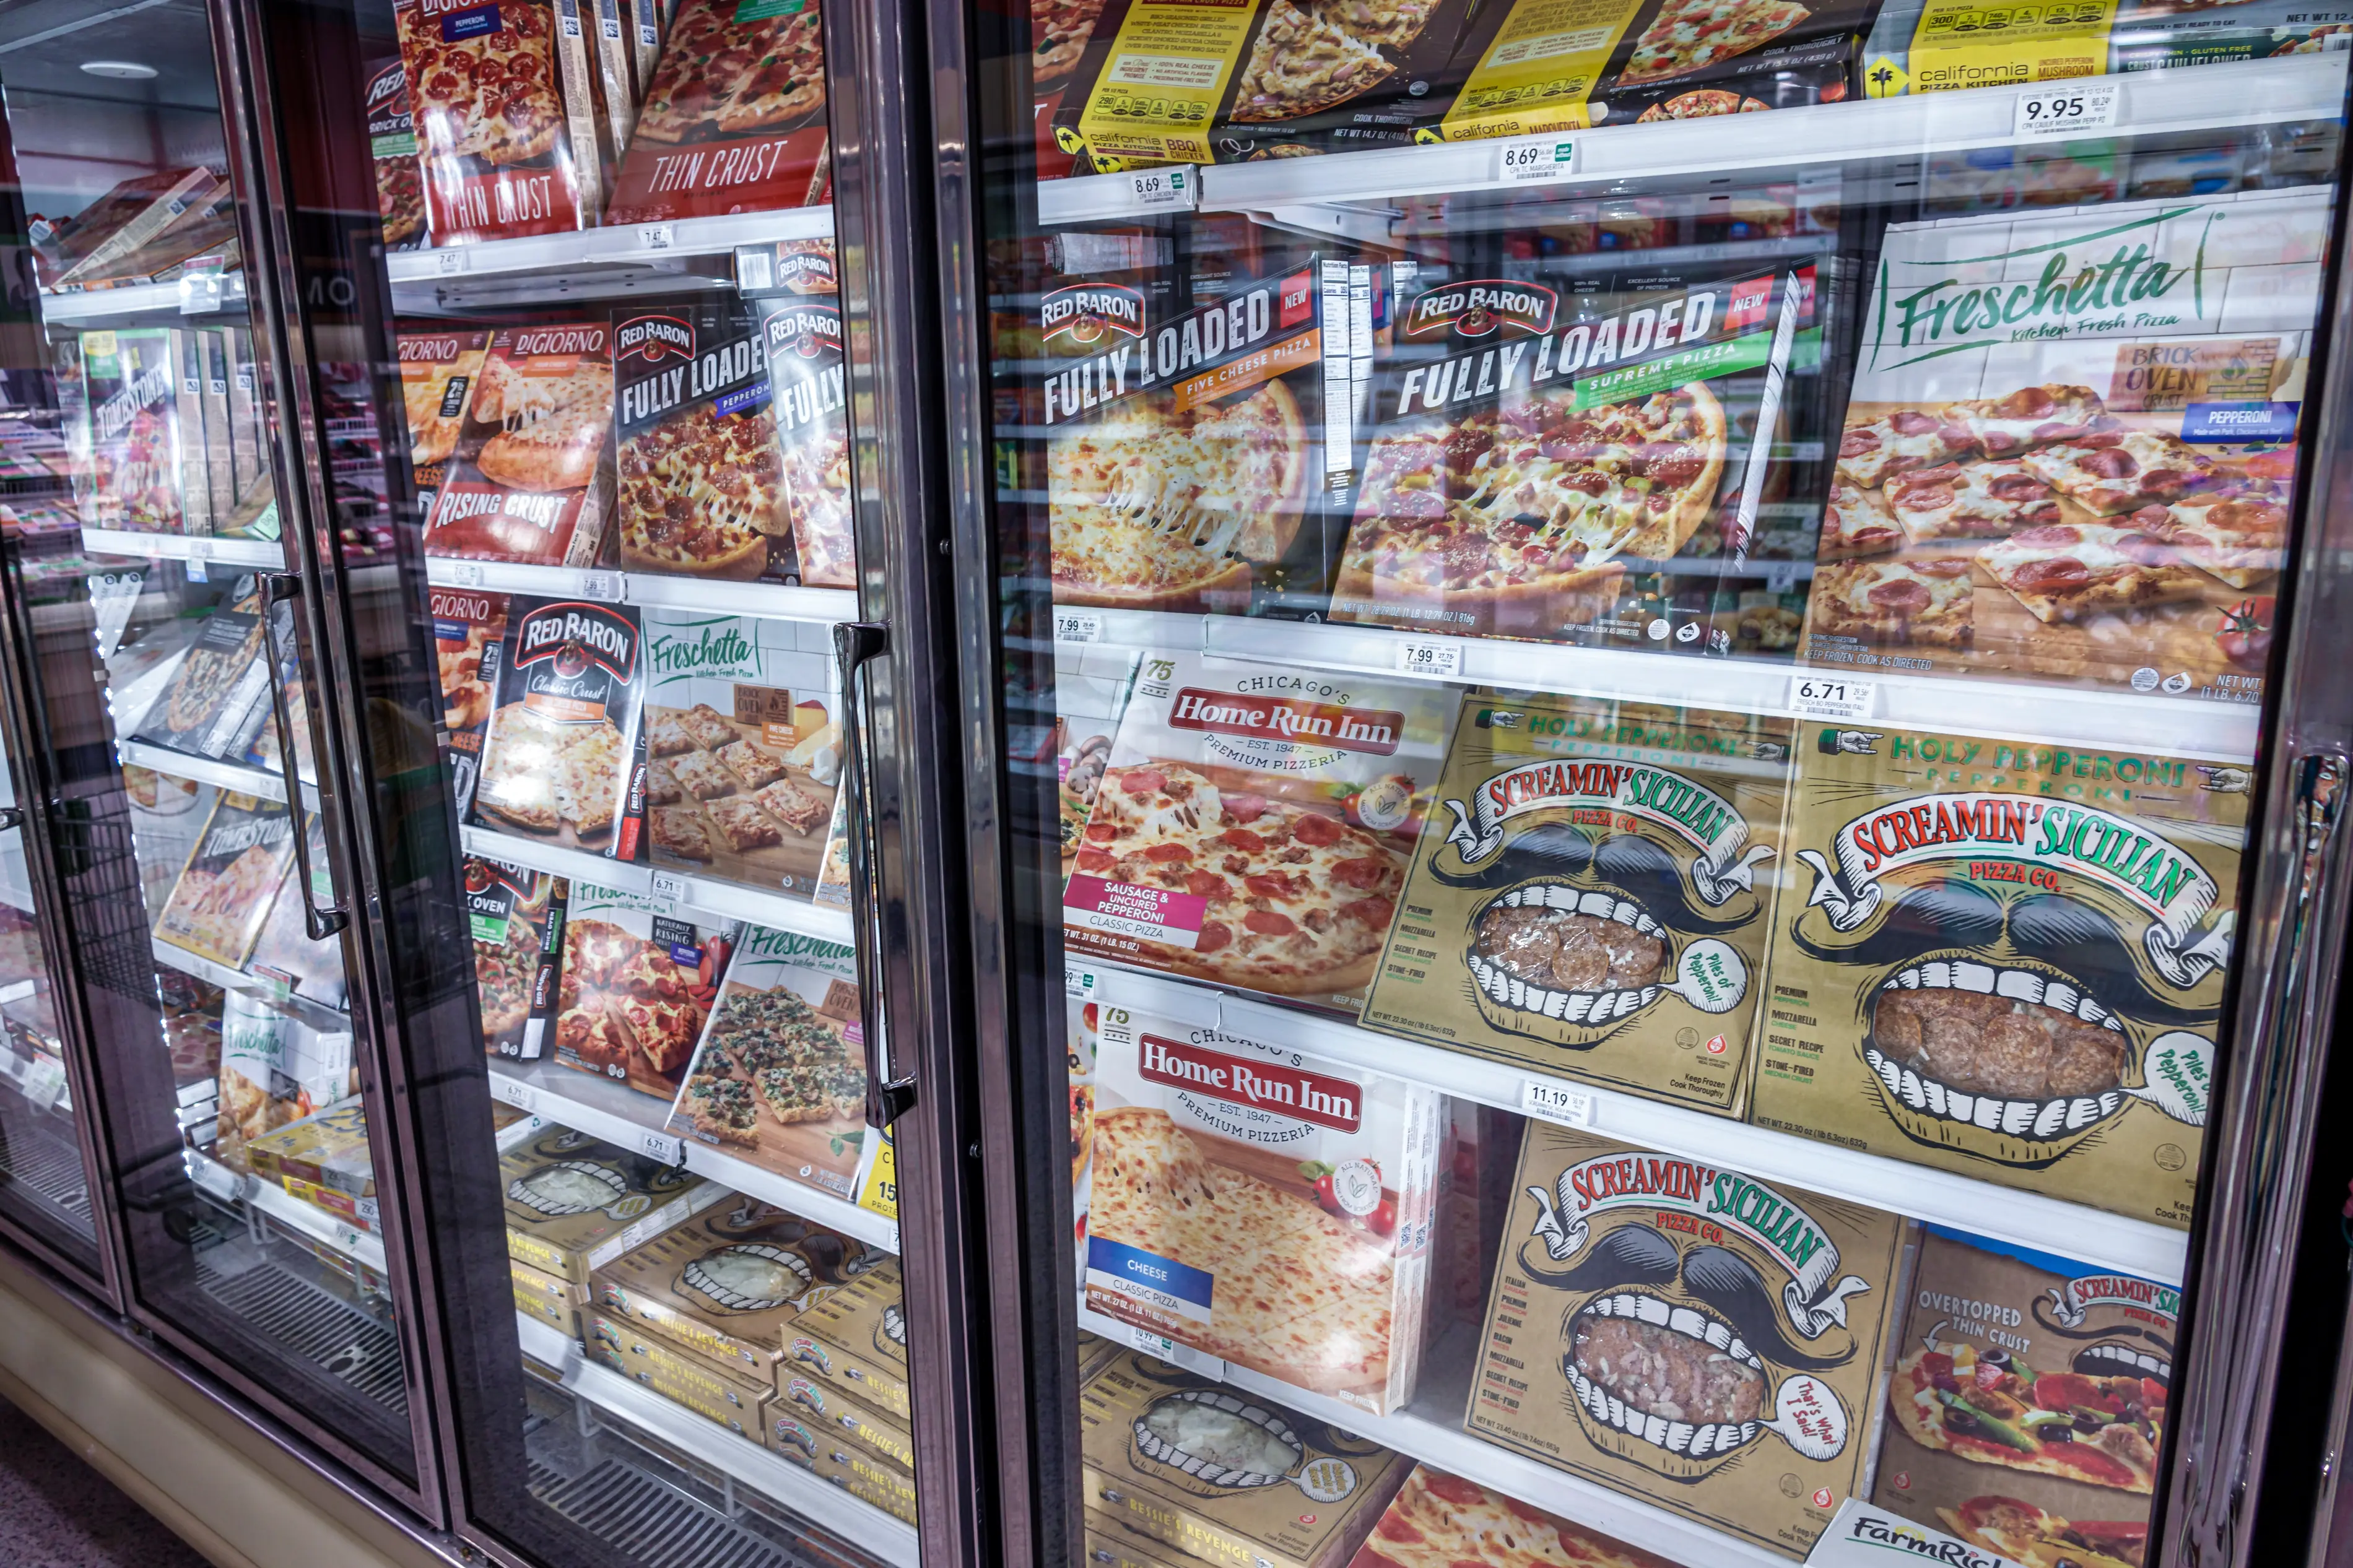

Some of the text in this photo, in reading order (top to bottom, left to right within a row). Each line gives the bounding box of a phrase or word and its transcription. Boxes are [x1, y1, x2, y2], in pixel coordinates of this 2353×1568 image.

[455, 15, 485, 27] PEPPERONI
[1931, 16, 1954, 24] 300
[2286, 13, 2330, 23] NET WT
[1763, 35, 1844, 57] COOK THOROUGHLY
[2191, 46, 2226, 54] GLUTEN
[1920, 62, 2029, 82] california
[2038, 65, 2094, 77] MUSHROOM
[2128, 60, 2154, 71] CRUST
[368, 71, 405, 105] RED
[1354, 114, 1372, 123] COOK
[2026, 97, 2084, 120] 9.95
[1090, 131, 1161, 145] california
[1453, 119, 1520, 139] california
[1166, 139, 1197, 152] BBQ
[1170, 150, 1206, 161] CHICKEN
[648, 140, 788, 193] THIN CRUST
[1505, 148, 1537, 166] 8.69
[683, 190, 726, 200] ORIGINAL
[1136, 178, 1159, 193] 8.69
[445, 176, 551, 230] THIN CRUST
[645, 232, 661, 242] 7.47
[440, 254, 456, 264] 7.47
[780, 256, 830, 276] RED BARON
[1284, 288, 1307, 310] NEW
[1419, 287, 1544, 322] RED BARON
[1733, 292, 1765, 313] NEW
[1895, 243, 2191, 347] Freschetta
[1042, 292, 1136, 329] RED BARON
[620, 322, 690, 349] RED BARON
[2011, 312, 2182, 343] Kitchen Fresh Pizza
[1045, 345, 1130, 425] FULLY
[1141, 290, 1269, 385] LOADED
[1397, 341, 1528, 415] FULLY
[1533, 292, 1716, 382] LOADED
[2133, 346, 2200, 366] BRICK
[1187, 376, 1214, 395] FIVE
[1219, 354, 1268, 381] CHEESE
[1274, 337, 1311, 360] PIZZA
[1590, 343, 1735, 391] SUPREME PIZZA
[622, 334, 768, 425] FULLY LOADE
[2126, 367, 2198, 391] OVEN
[97, 365, 165, 441] TOMBSTONE
[782, 363, 844, 431] FULLY
[2143, 394, 2185, 409] CRUST
[2208, 410, 2273, 424] PEPPERONI
[435, 493, 568, 534] RISING CRUST
[1059, 619, 1079, 631] 7.99
[525, 613, 629, 663] RED BARON
[651, 627, 754, 674] Freschetta
[1407, 649, 1433, 662] 7.99
[1803, 649, 1932, 670] KEEP FROZEN, COOK AS DIRECTED
[531, 674, 607, 700] Classic Crust
[737, 687, 761, 699] BRICK
[1237, 675, 1351, 706] CHICAGO'S
[1800, 682, 1845, 701] 6.71
[2217, 675, 2261, 690] NET WT.
[2201, 685, 2259, 703] (1 LB. 6.70
[737, 699, 761, 713] OVEN
[1174, 695, 1393, 744] Home Run Inn
[1529, 714, 1739, 756] HOLY PEPPERONI
[1204, 733, 1348, 770] PREMIUM PIZZERIA
[1246, 739, 1302, 755] EST. 1947
[1890, 736, 2186, 787] HOLY PEPPERONI
[630, 767, 645, 810] RED BARON
[1926, 768, 2131, 802] PEPPERONI
[1489, 762, 1738, 846] SCREAMIN' SICILIAN
[1572, 809, 1638, 833] PIZZA CO.
[204, 816, 291, 859] TOMBSTON
[1853, 800, 2196, 908] SCREAMIN' SICILIAN
[656, 879, 674, 891] 6.71
[1969, 862, 2061, 893] PIZZA CO.
[1104, 881, 1168, 904] SAUSAGE &
[1110, 894, 1158, 911] UNCURED
[474, 897, 506, 914] OVEN
[1097, 901, 1165, 924] PEPPERONI
[1407, 904, 1433, 916] PREMIUM
[656, 918, 690, 933] NATURALLY
[1090, 916, 1163, 938] CLASSIC PIZZA
[656, 929, 690, 946] RISING
[1394, 944, 1437, 959] SECRET RECIPE
[537, 968, 549, 991] BARON
[830, 995, 855, 1012] OVEN
[1332, 994, 1350, 1005] KEEP
[1772, 1010, 1817, 1026] MOZZARELLA
[1769, 1034, 1824, 1053] SECRET RECIPE
[1765, 1059, 1814, 1076] STONE-FIRED
[1143, 1042, 1228, 1089] Home
[1231, 1064, 1295, 1106] Run
[1300, 1080, 1355, 1121] Inn
[1670, 1079, 1724, 1099] Cook Thoroughly
[1684, 1073, 1726, 1089] Keep Frozen
[507, 1086, 522, 1098] 6.71
[1533, 1086, 1568, 1107] 11.19
[1177, 1091, 1316, 1143] PREMIUM PIZZERIA
[1219, 1103, 1271, 1124] EST. 1947
[1757, 1115, 1770, 1125] NET
[1772, 1119, 1783, 1128] WT.
[1784, 1122, 1803, 1133] 22.30
[1827, 1132, 1849, 1145] 6.3oz)
[1849, 1137, 1868, 1150] 632g
[646, 1137, 663, 1151] 6.71
[1572, 1158, 1825, 1270] SCREAMIN' SICILIAN
[2155, 1207, 2178, 1220] Cook
[1656, 1213, 1725, 1246] PIZZA CO.
[1127, 1260, 1168, 1281] CHEESE
[1113, 1280, 1178, 1310] CLASSIC PIZZA
[2074, 1277, 2160, 1304] SCREAMIN'
[1919, 1290, 2022, 1328] OVERTOPPED
[1952, 1316, 2030, 1354] THIN CRUST
[1129, 1497, 1250, 1562] BESSIE'S REVENGE
[1778, 1530, 1795, 1540] Cook
